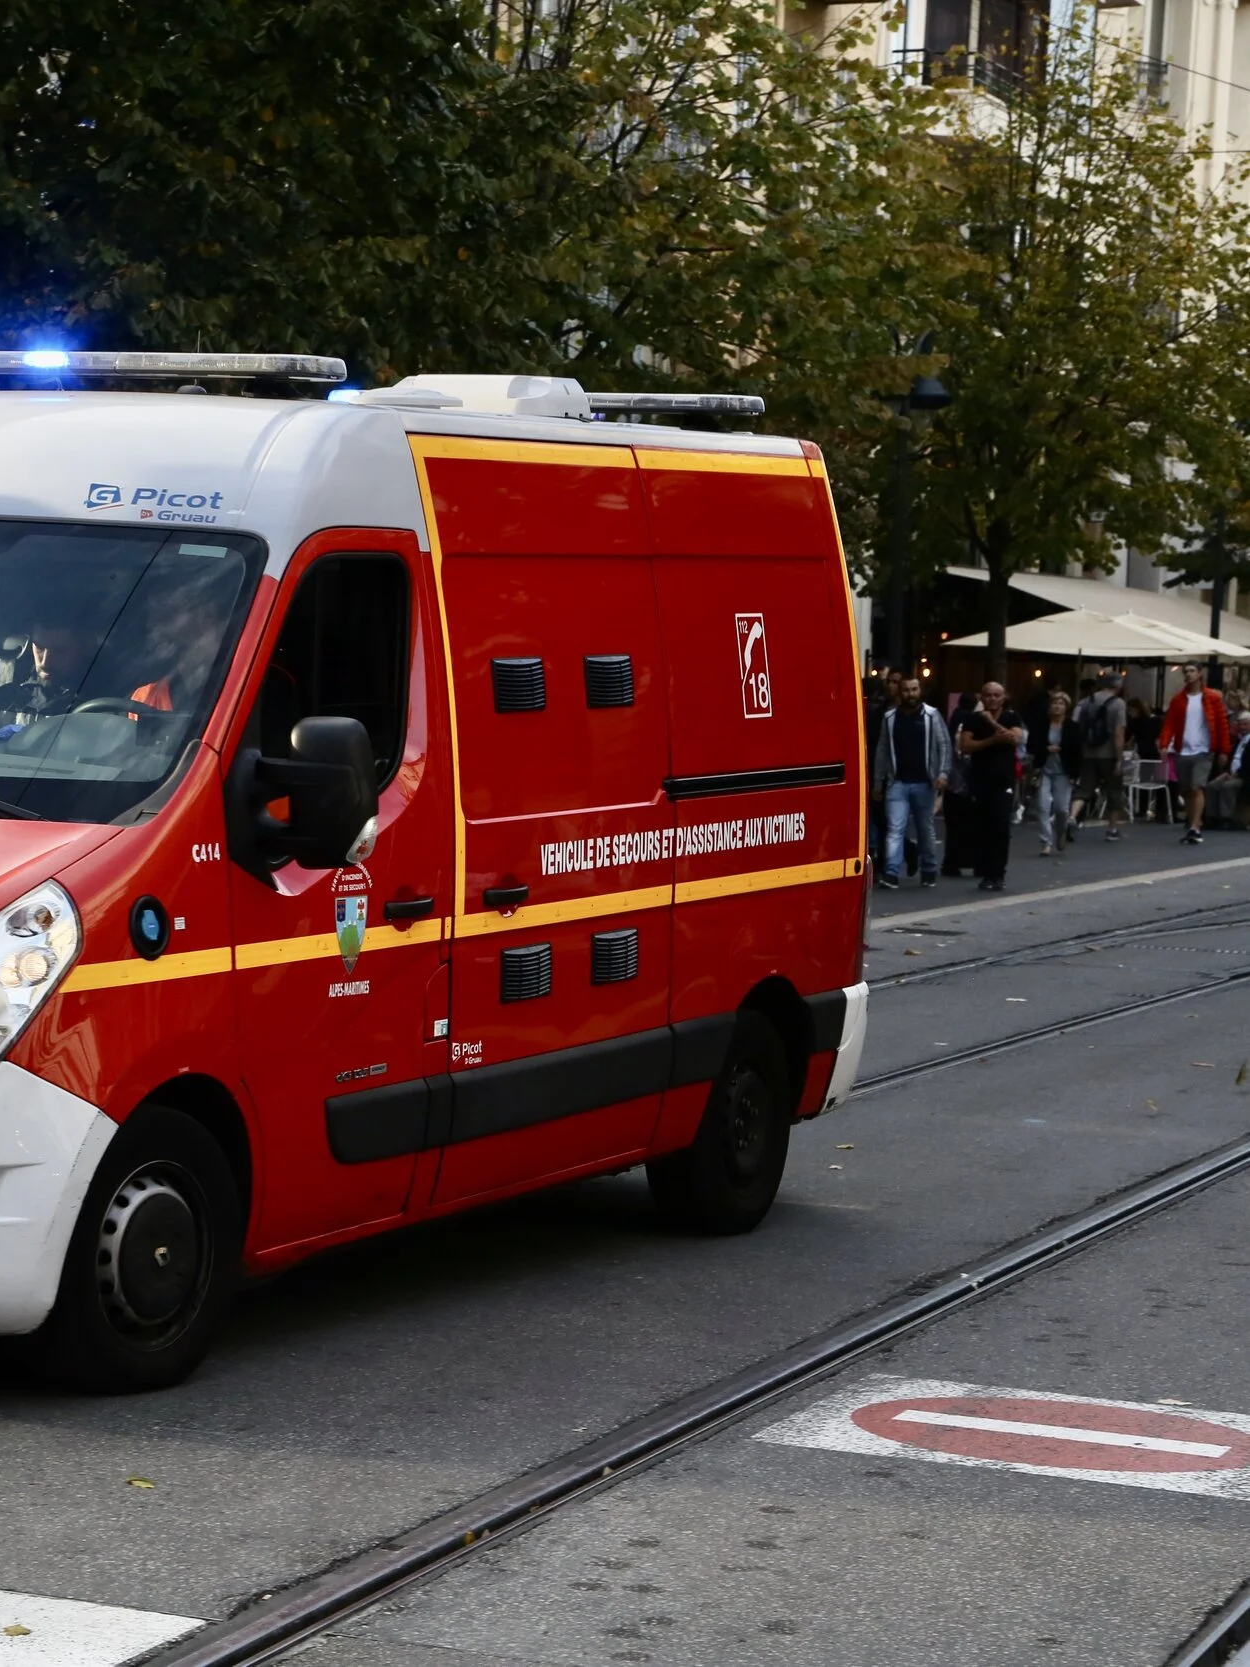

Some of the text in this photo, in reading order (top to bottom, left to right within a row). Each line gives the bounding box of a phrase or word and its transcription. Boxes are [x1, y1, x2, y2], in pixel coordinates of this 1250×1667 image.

[131, 488, 223, 510] Picot
[157, 510, 217, 524] Gruau
[738, 620, 749, 634] 112
[749, 672, 769, 709] 18
[191, 842, 221, 863] C414
[540, 811, 806, 876] VEHICULE DE SECOURS ET D'ASSISTANCE AUX VICTIMES
[462, 1040, 482, 1056] Picot
